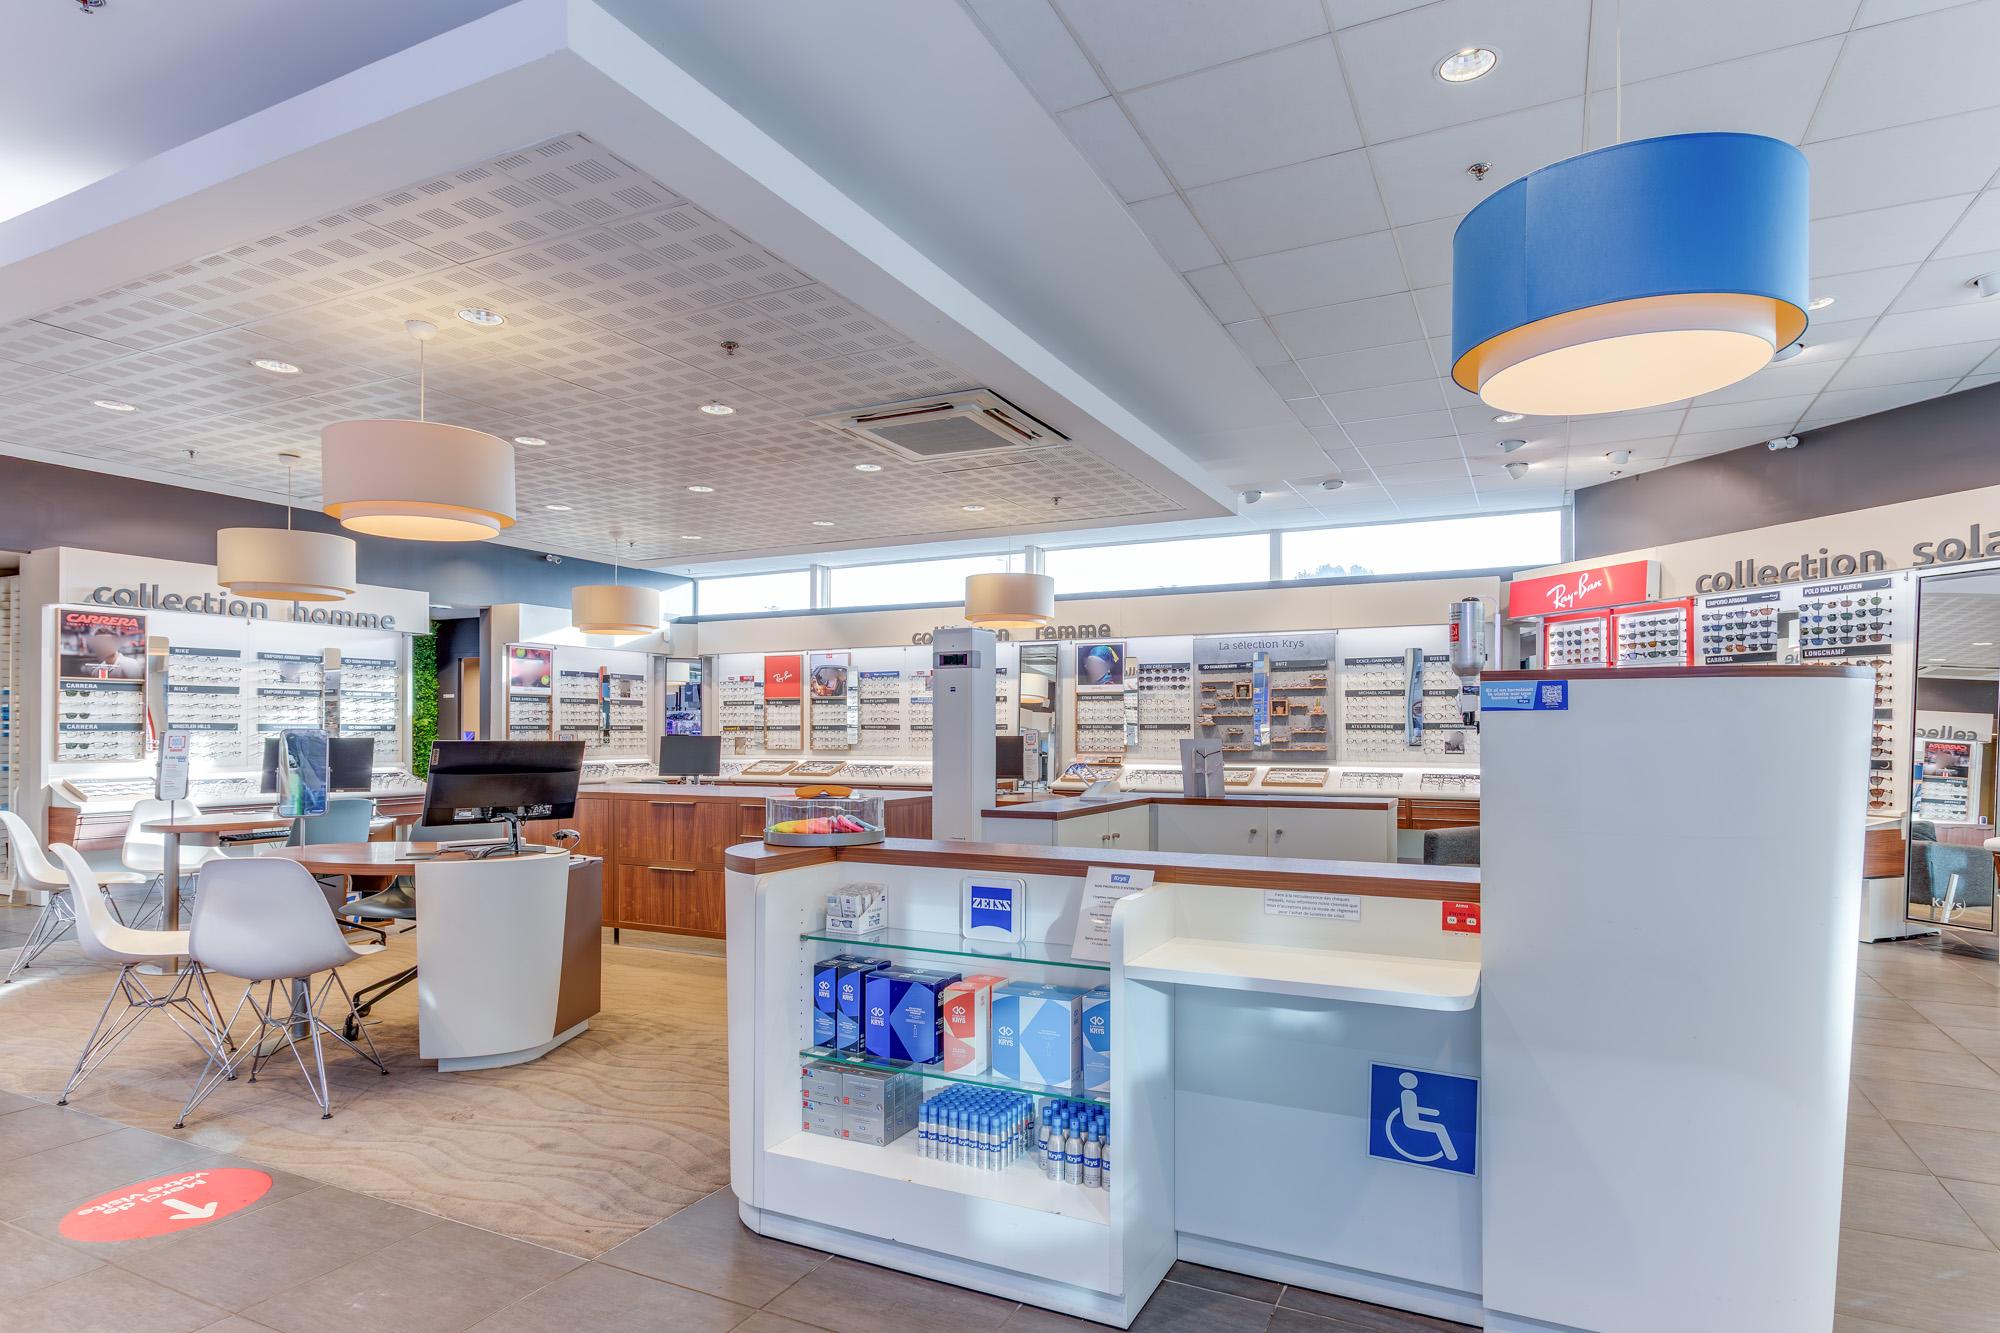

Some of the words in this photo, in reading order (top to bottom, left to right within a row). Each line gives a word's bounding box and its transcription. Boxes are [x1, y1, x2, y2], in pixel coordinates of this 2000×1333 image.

[1695, 547, 1885, 594] collection
[1546, 572, 1603, 609] Ray-Ban
[1804, 586, 1819, 596] POLO
[1819, 584, 1838, 595] RALPH
[1839, 582, 1863, 592] LAUREN
[92, 582, 269, 619] collection
[293, 599, 396, 630] homme
[66, 613, 139, 627] CARRERA
[1218, 642, 1230, 650] La
[1232, 640, 1279, 650] sélection
[1282, 639, 1305, 650] Krys
[1804, 648, 1846, 657] LONGCHAMP
[1706, 656, 1734, 664] CARRERA
[66, 682, 98, 690] CARRERA
[971, 896, 1012, 912] ZEISS
[842, 994, 854, 1002] KRYS
[870, 1019, 885, 1027] KRYS
[952, 1016, 966, 1024] KRYS
[1089, 1027, 1105, 1035] KRYS
[998, 1038, 1014, 1047] KRYS
[1048, 1152, 1062, 1160] Krys
[1066, 1155, 1082, 1163] Krys
[147, 1172, 209, 1193] votre
